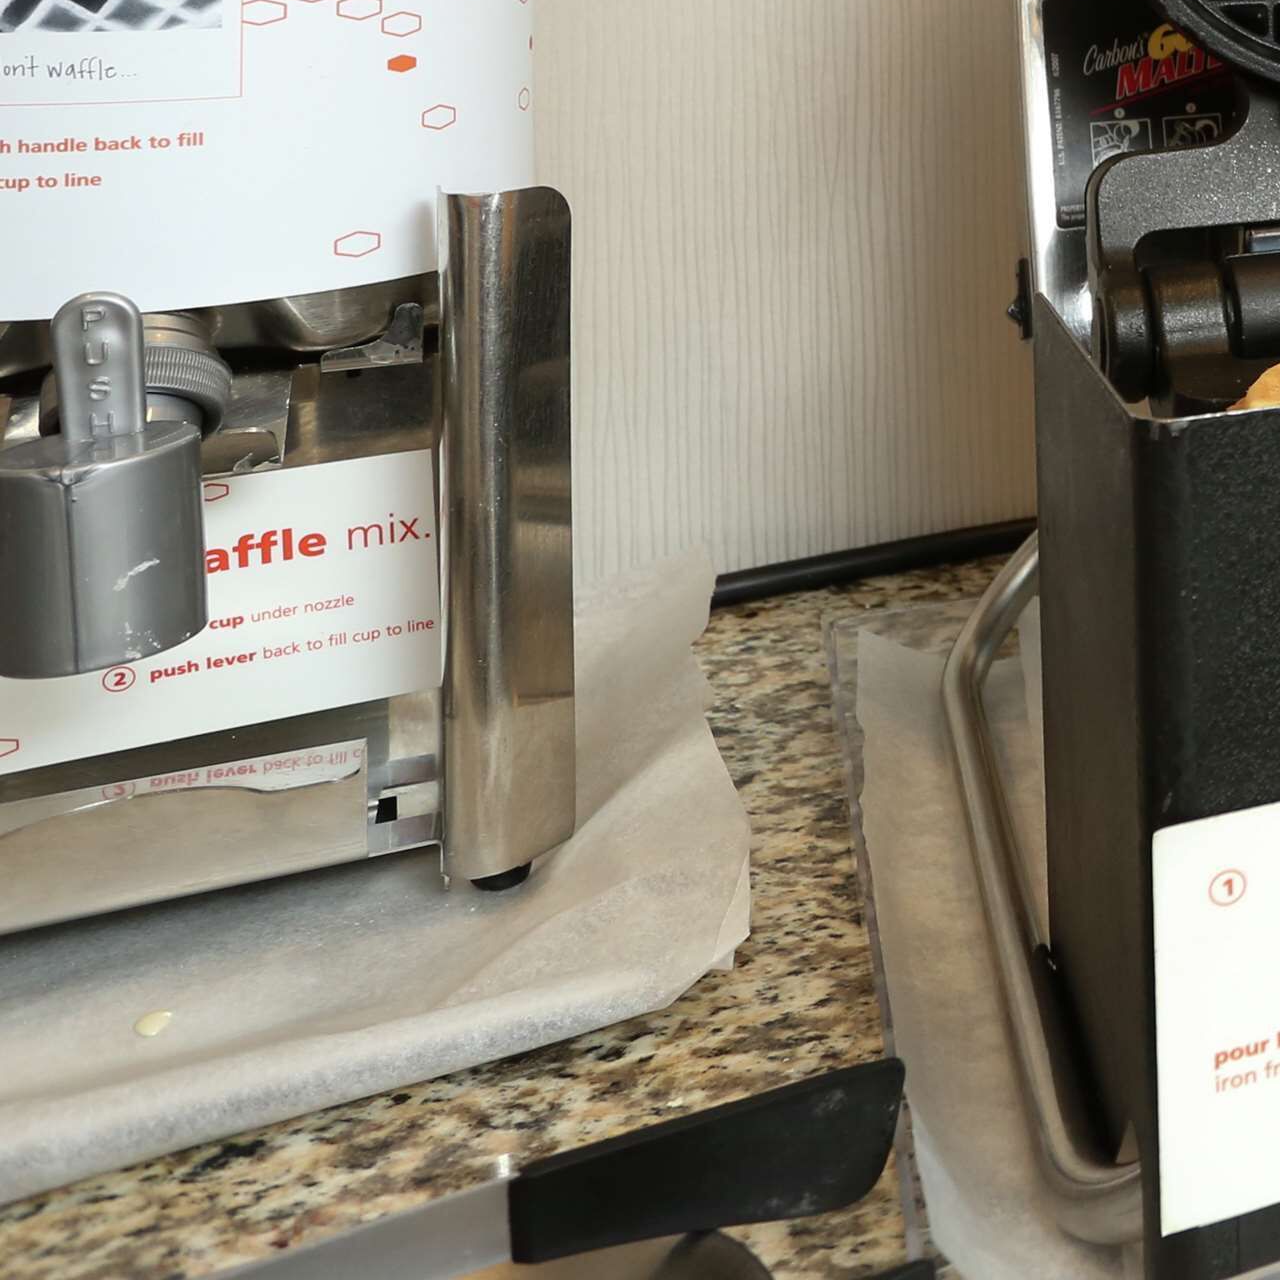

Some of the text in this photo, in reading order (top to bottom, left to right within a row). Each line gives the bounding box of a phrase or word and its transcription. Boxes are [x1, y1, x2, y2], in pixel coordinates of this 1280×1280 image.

[1, 55, 38, 78] on't
[1083, 32, 1147, 76] Carbon's
[18, 137, 87, 154] handle
[94, 135, 141, 152] back
[148, 136, 171, 149] to
[177, 132, 204, 147] fill
[35, 176, 58, 188] to
[64, 173, 102, 187] line
[82, 305, 115, 436] PUSH
[205, 513, 431, 575] affle mix.
[209, 594, 355, 630] cup under nozzle
[150, 660, 200, 683] push
[206, 652, 257, 669] lever
[262, 642, 300, 659] back
[306, 638, 324, 652] to
[328, 632, 348, 647] fill
[352, 629, 381, 644] cup
[386, 624, 402, 637] to
[407, 618, 434, 633] line
[1213, 1038, 1270, 1070] pour
[1215, 1070, 1257, 1093] iron
